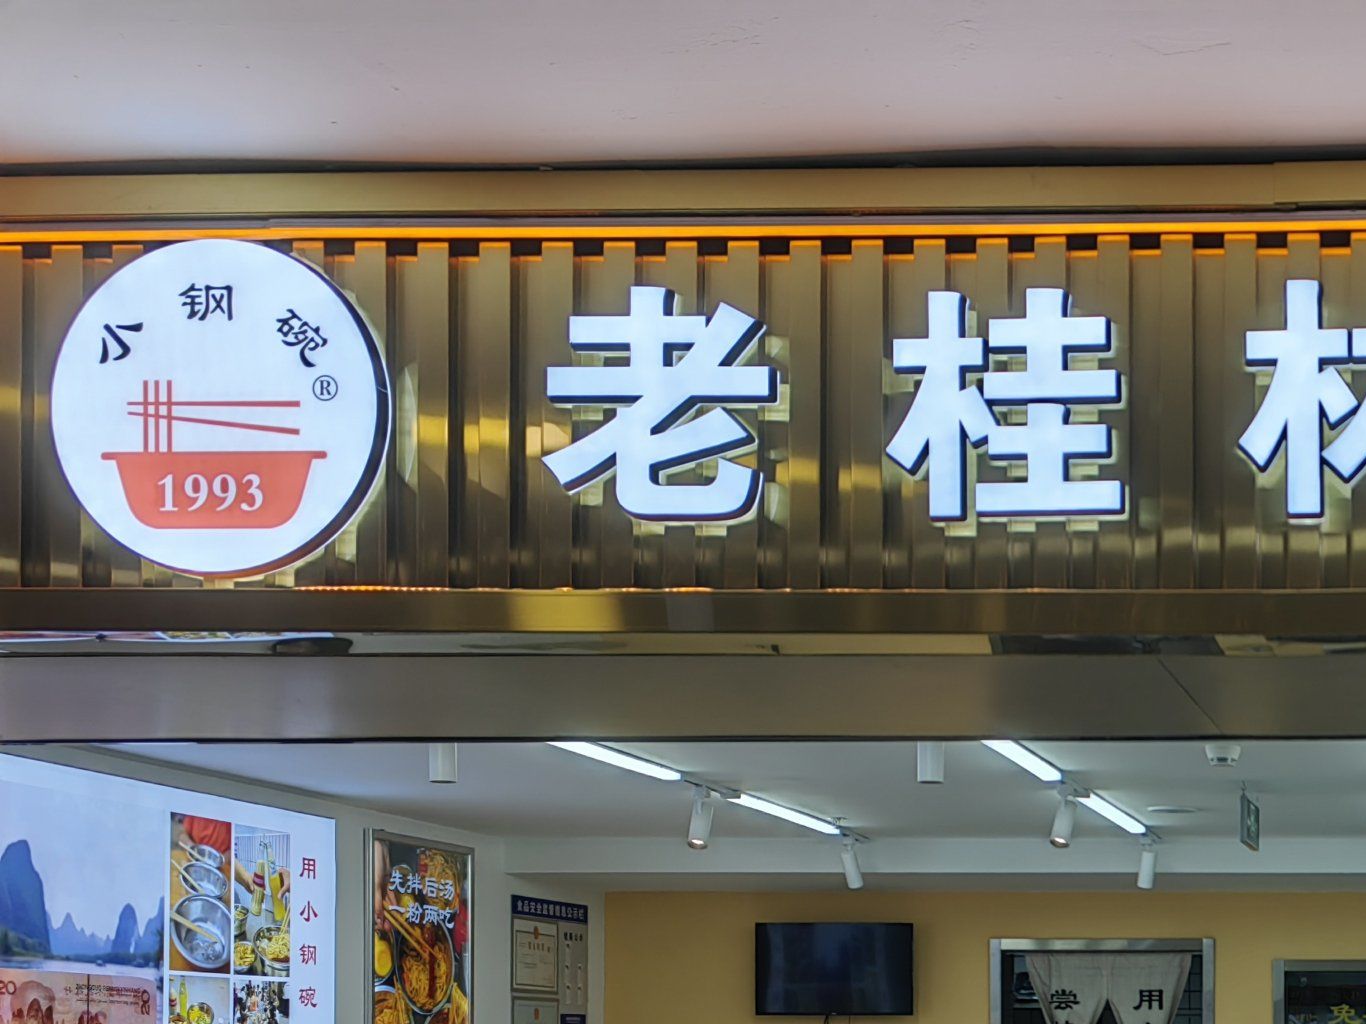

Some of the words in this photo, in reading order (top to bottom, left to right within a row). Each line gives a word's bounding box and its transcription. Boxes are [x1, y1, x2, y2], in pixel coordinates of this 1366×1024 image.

[99, 283, 328, 368] 小钢碗
[156, 474, 264, 512] 1993
[389, 871, 455, 901] 先拌后汤
[389, 903, 455, 929] 一粉两吃
